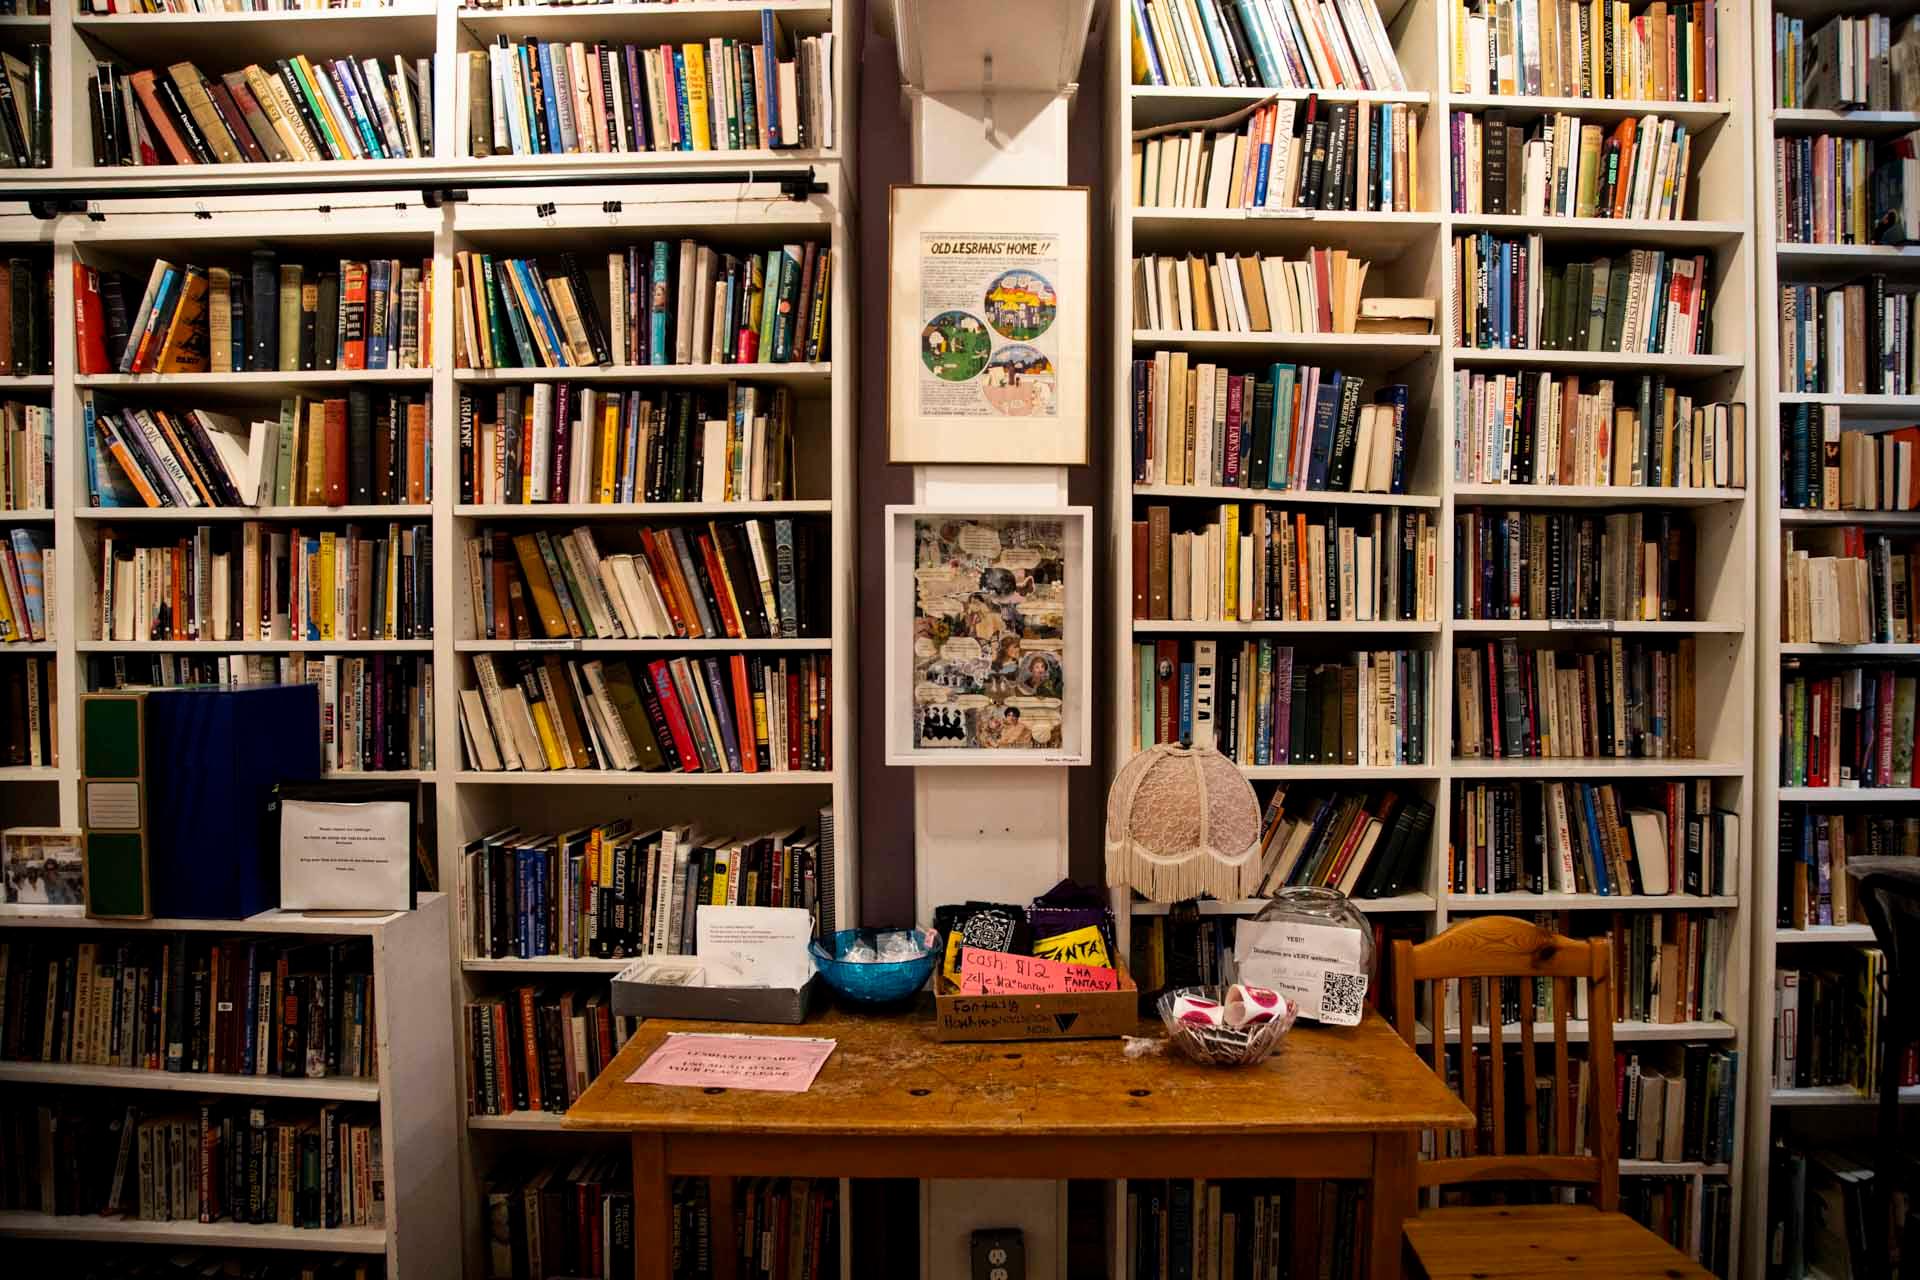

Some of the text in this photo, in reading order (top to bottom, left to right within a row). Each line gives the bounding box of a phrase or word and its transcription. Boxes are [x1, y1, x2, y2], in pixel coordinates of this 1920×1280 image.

[1580, 6, 1589, 32] SARTON
[1488, 28, 1497, 70] Recovering
[1582, 40, 1590, 62] World
[1604, 21, 1612, 75] MAY SARTON
[600, 50, 613, 107] RESTRICTED COUNTRY
[1581, 71, 1590, 91] Light
[281, 99, 304, 130] MOON
[300, 130, 318, 153] VOW
[1275, 104, 1292, 157] AMAZON
[1544, 126, 1552, 140] The
[1608, 153, 1618, 185] DEAD ENDS
[654, 242, 667, 284] CHOICES
[932, 243, 951, 255] OLD
[1482, 262, 1488, 271] NO
[372, 290, 384, 336] WIND ROSE
[1624, 317, 1638, 352] LETTERS
[460, 396, 472, 448] ARIADNE
[1335, 382, 1352, 457] BLACKBERRY WINTER
[1344, 382, 1360, 448] MARGARET MEAD
[1228, 426, 1240, 473] LADY'S MAID
[1809, 405, 1818, 480] THE NIGHT WATCH
[1510, 520, 1519, 542] STAY
[1198, 666, 1211, 721] RITA
[1882, 704, 1891, 724] SUSAN
[1882, 735, 1892, 770] ANTHONY
[1560, 827, 1568, 852] MACHO
[591, 851, 599, 880] FRIEDMAN
[615, 850, 626, 899] VELOCITY
[728, 849, 740, 901] Kamikaze Lust
[792, 848, 803, 893] Uncovered
[1562, 854, 1570, 873] SLUTS
[590, 886, 598, 915] SPANKING
[590, 915, 598, 940] WATSON
[1016, 959, 1050, 979] $12
[1064, 976, 1112, 990] FANTASY
[1066, 968, 1092, 978] LHA
[480, 1006, 490, 1035] SWEET
[483, 1036, 492, 1067] CREEK
